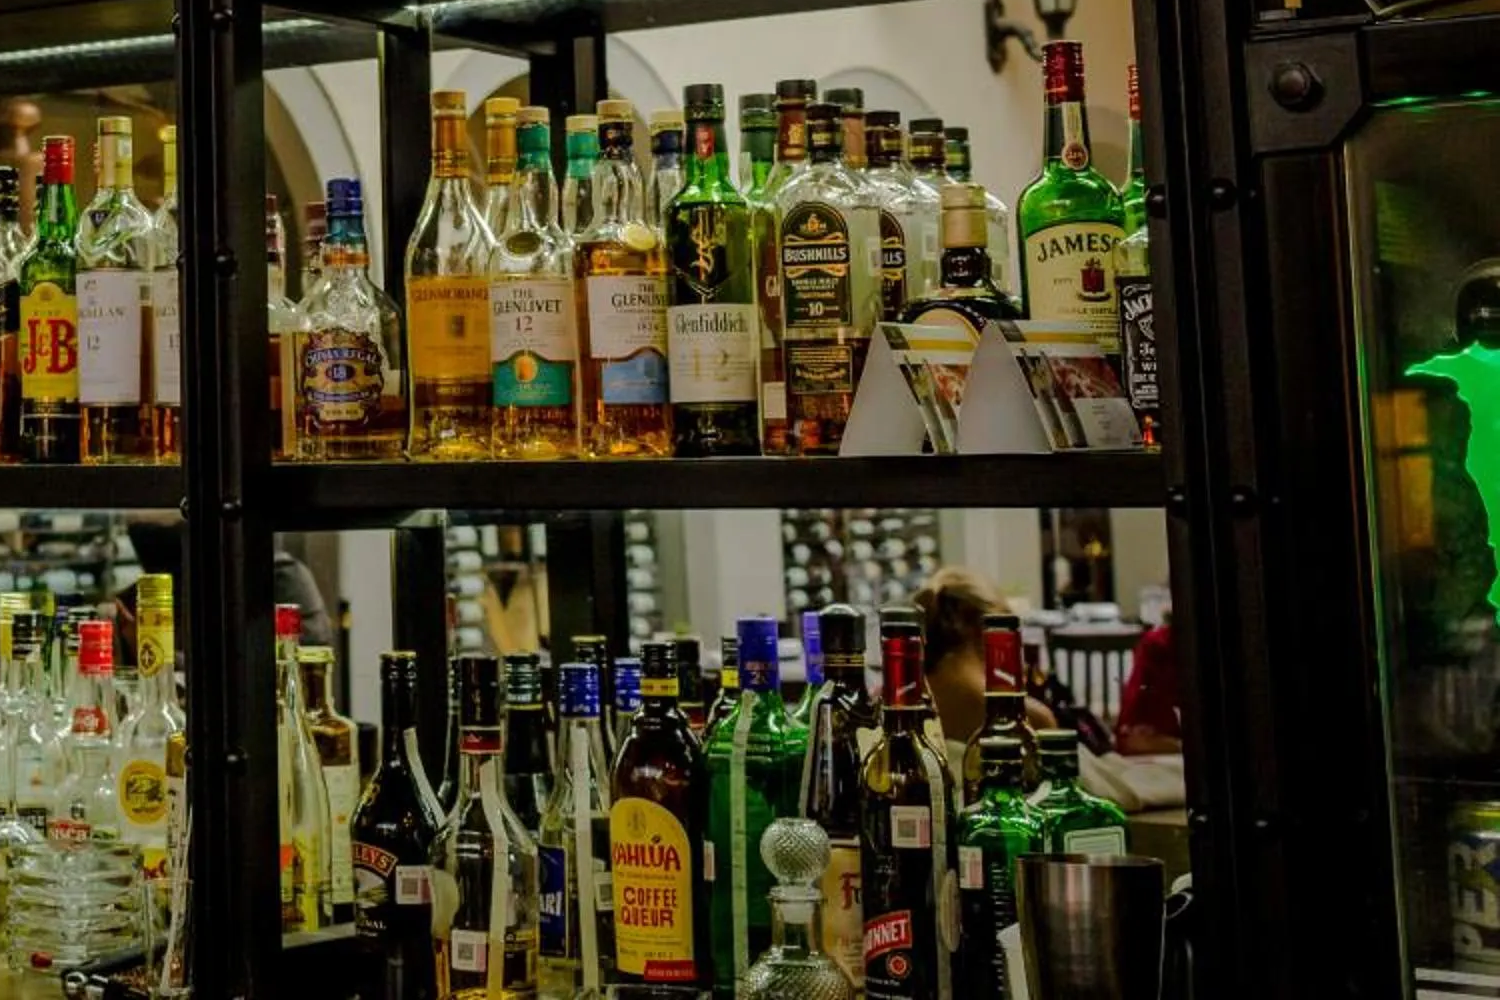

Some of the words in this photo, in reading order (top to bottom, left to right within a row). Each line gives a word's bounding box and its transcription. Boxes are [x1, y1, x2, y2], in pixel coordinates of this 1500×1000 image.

[784, 247, 848, 262] BUSHMILLS
[1037, 233, 1122, 263] JAMES
[513, 288, 533, 298] THE
[494, 299, 563, 315] GLENLIVET
[808, 302, 824, 315] 10
[515, 316, 533, 331] 12
[676, 311, 748, 334] Glenfiddich
[24, 319, 77, 374] J&B
[612, 835, 680, 871] AHLÚA
[623, 886, 676, 907] COFFEE
